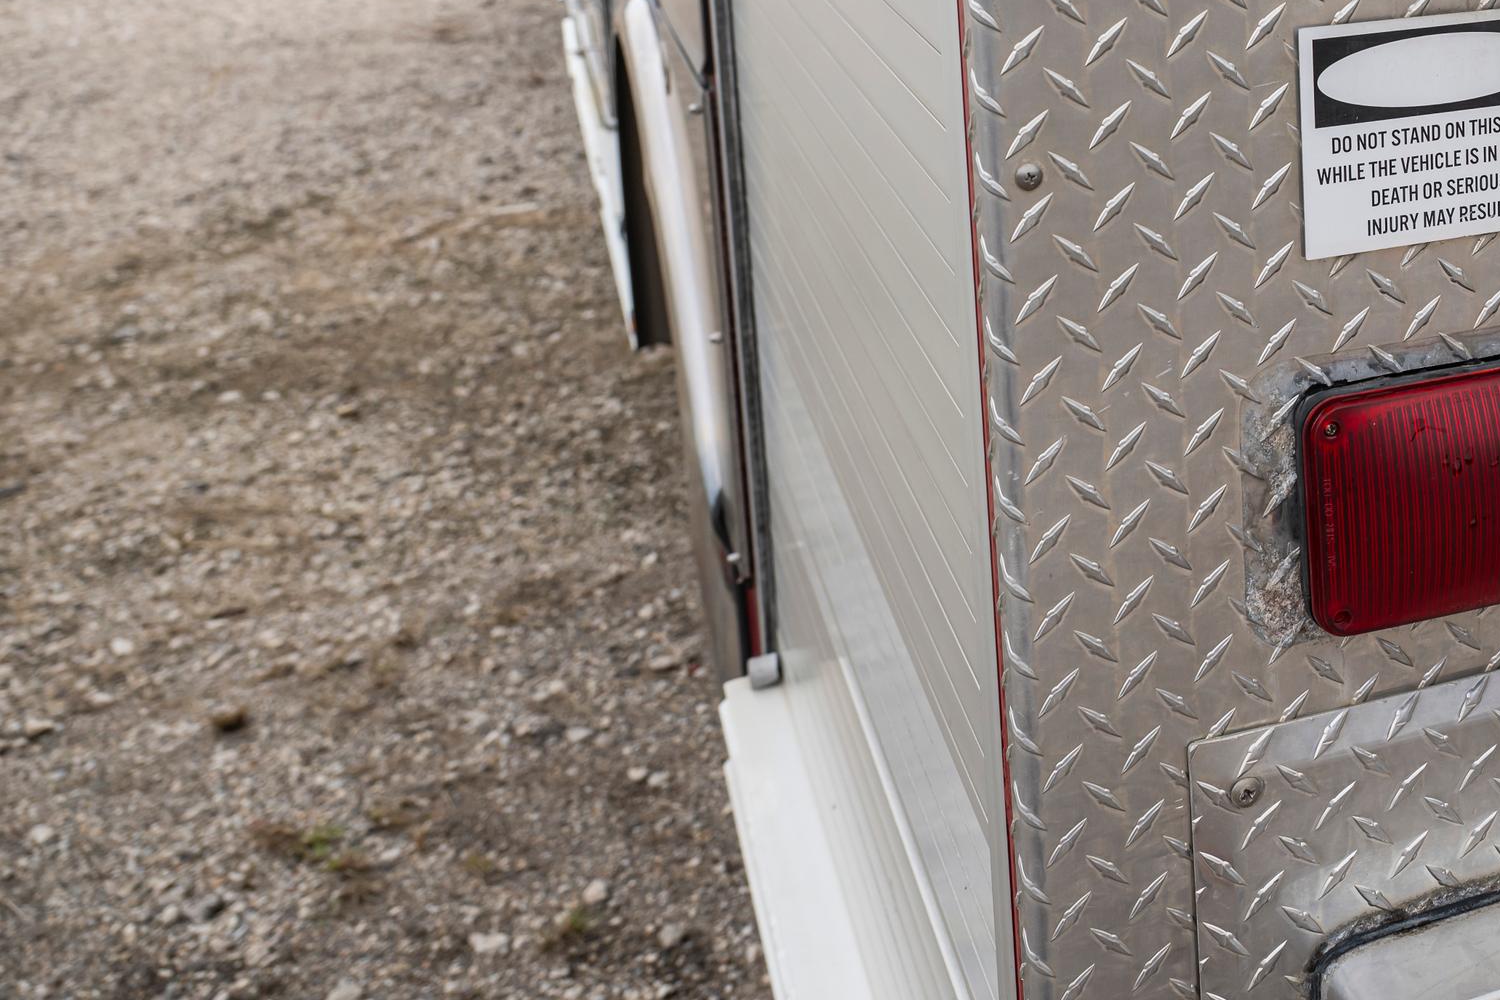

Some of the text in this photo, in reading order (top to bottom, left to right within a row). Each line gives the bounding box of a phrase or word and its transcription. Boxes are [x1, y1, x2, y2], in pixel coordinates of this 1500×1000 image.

[1331, 136, 1352, 154] DO
[1357, 131, 1388, 151] NOT
[1391, 125, 1441, 147] STAND
[1445, 121, 1465, 139] ON
[1317, 163, 1365, 185] WHILE
[1369, 159, 1397, 178] THE
[1401, 149, 1462, 172] VEHICLE
[1465, 148, 1479, 166] IS
[1482, 145, 1497, 163] IN
[1371, 185, 1418, 207] DEATH
[1423, 181, 1442, 199] OR
[1367, 213, 1419, 236] INJURY
[1423, 208, 1455, 228] MAY
